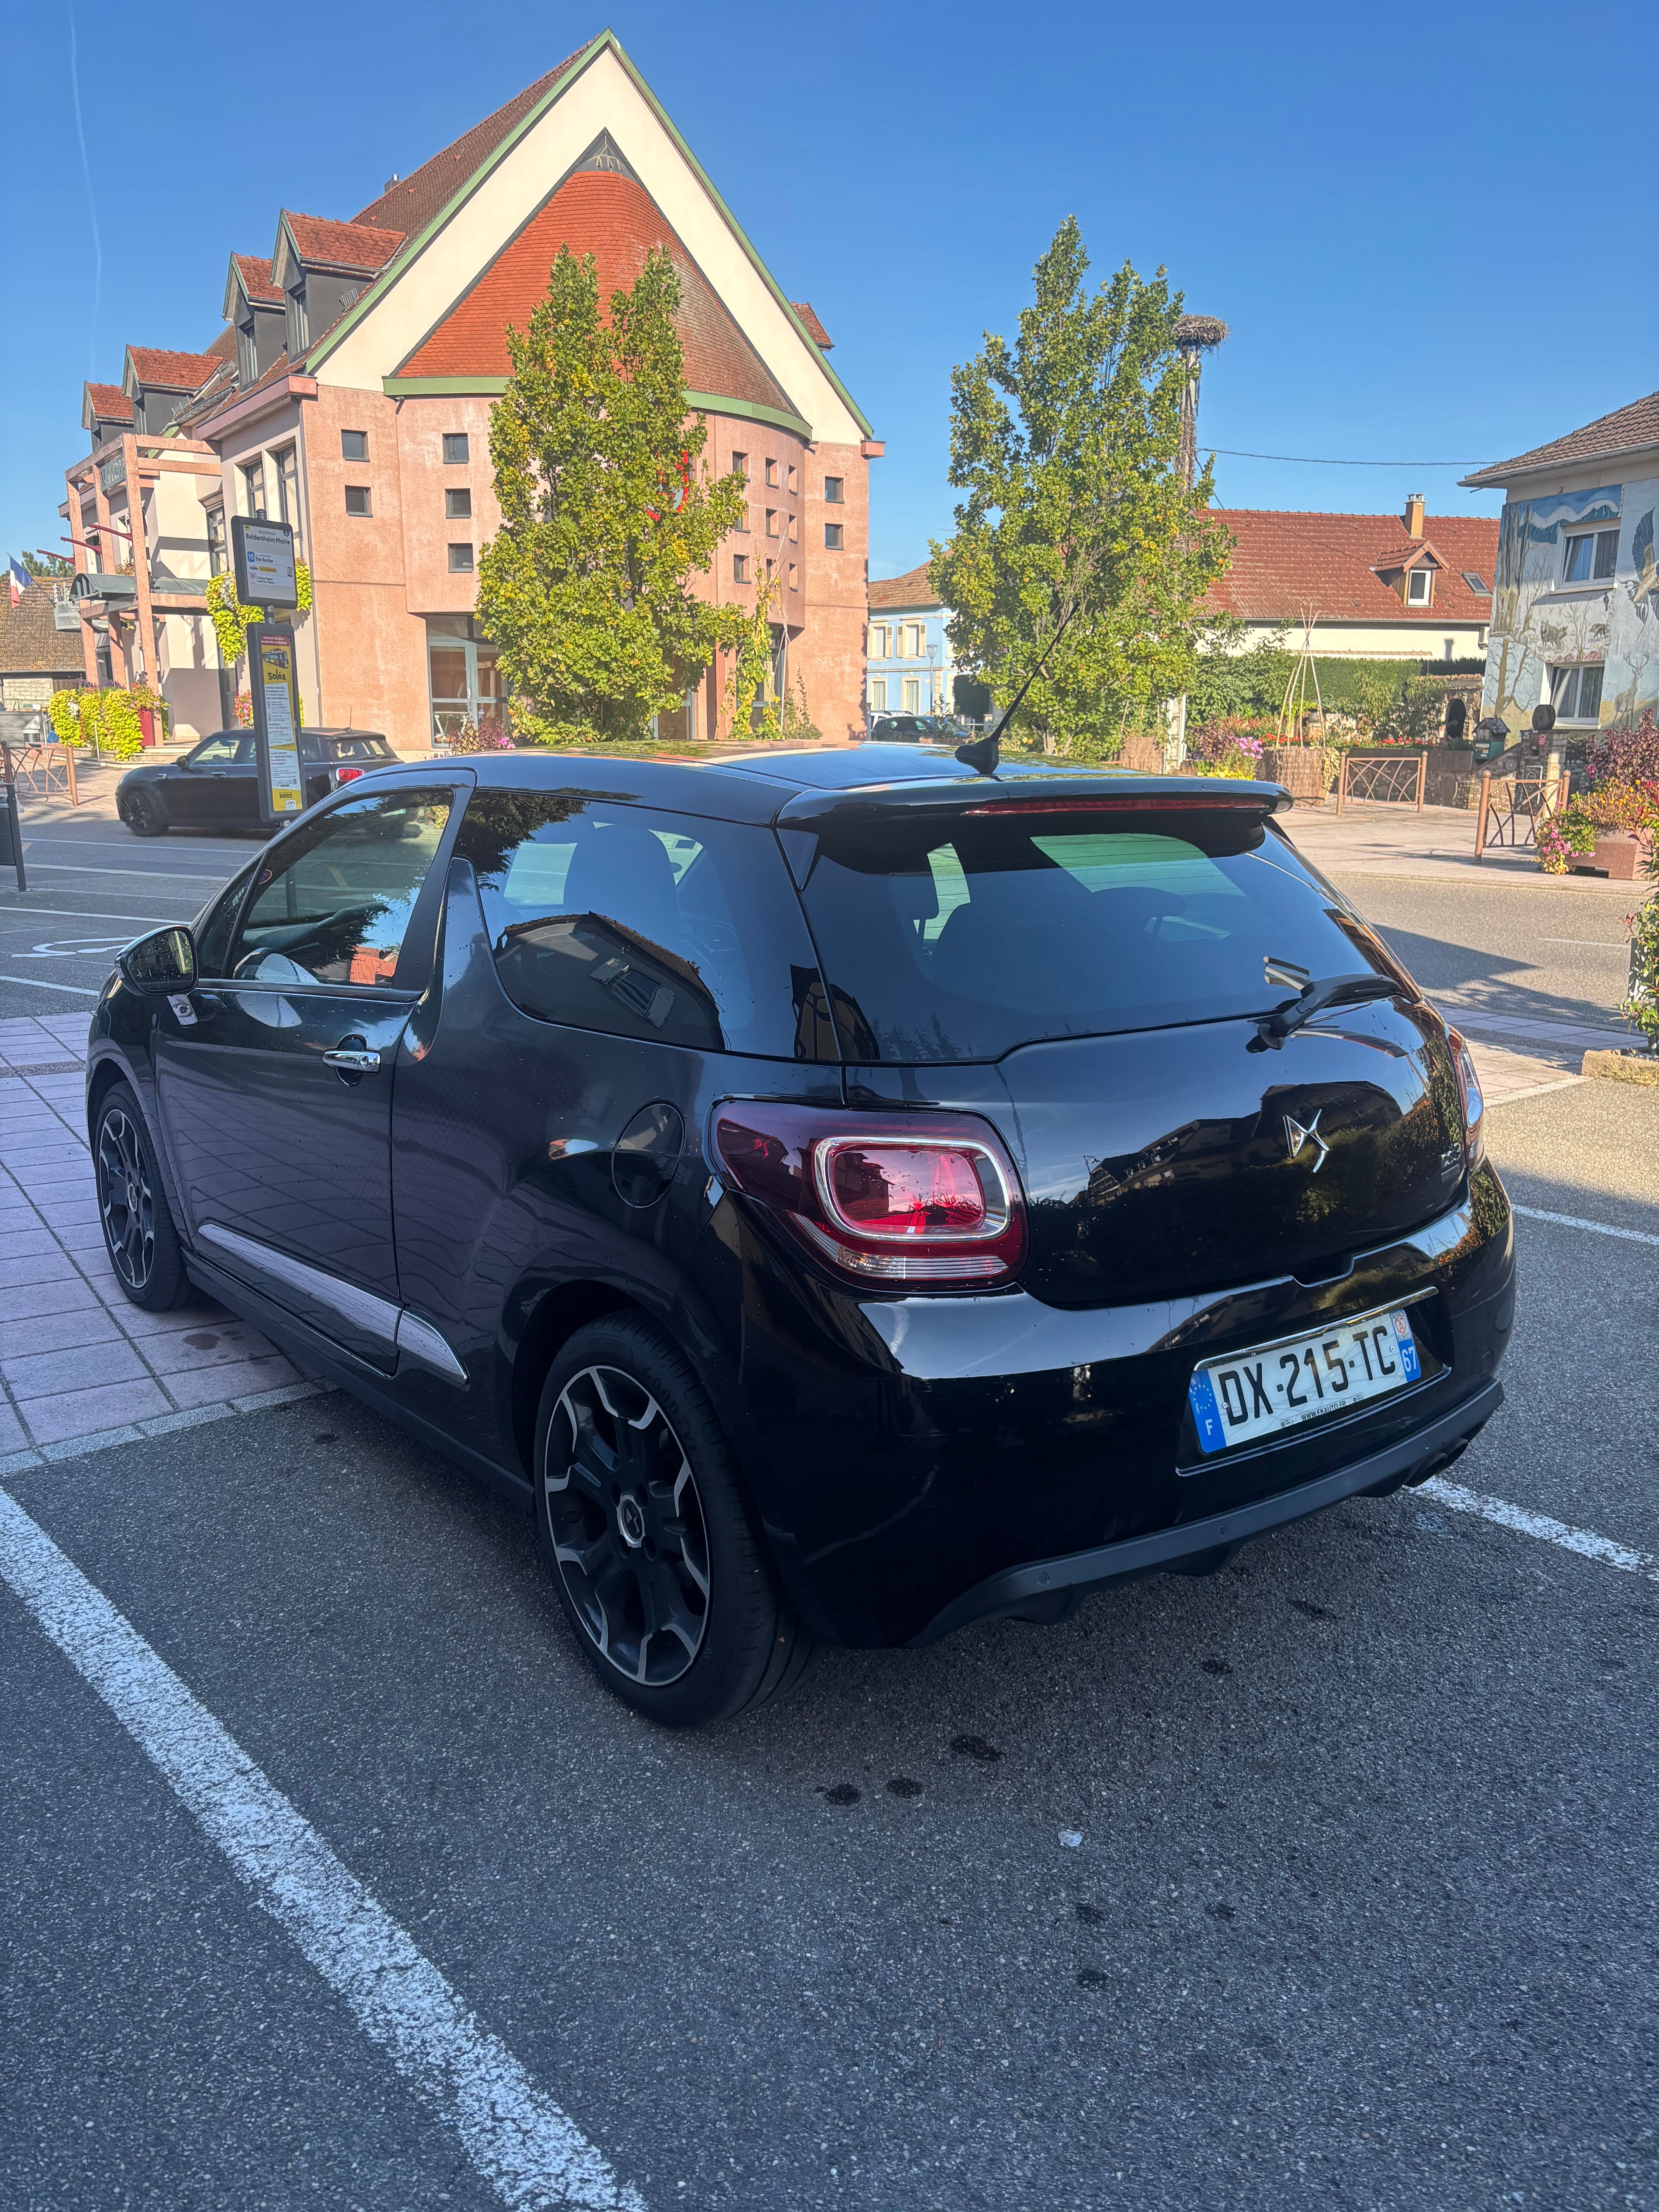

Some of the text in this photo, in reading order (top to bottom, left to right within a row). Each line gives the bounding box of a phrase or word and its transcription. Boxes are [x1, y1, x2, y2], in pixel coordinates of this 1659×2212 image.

[246, 533, 275, 543] Baldersheim
[1391, 1310, 1405, 1319] ALSACE
[1397, 1332, 1411, 1342] ELSASS
[1401, 1346, 1416, 1372] 67
[1300, 1400, 1346, 1422] WWW.FKAUTO.FR
[1205, 1418, 1213, 1435] F
